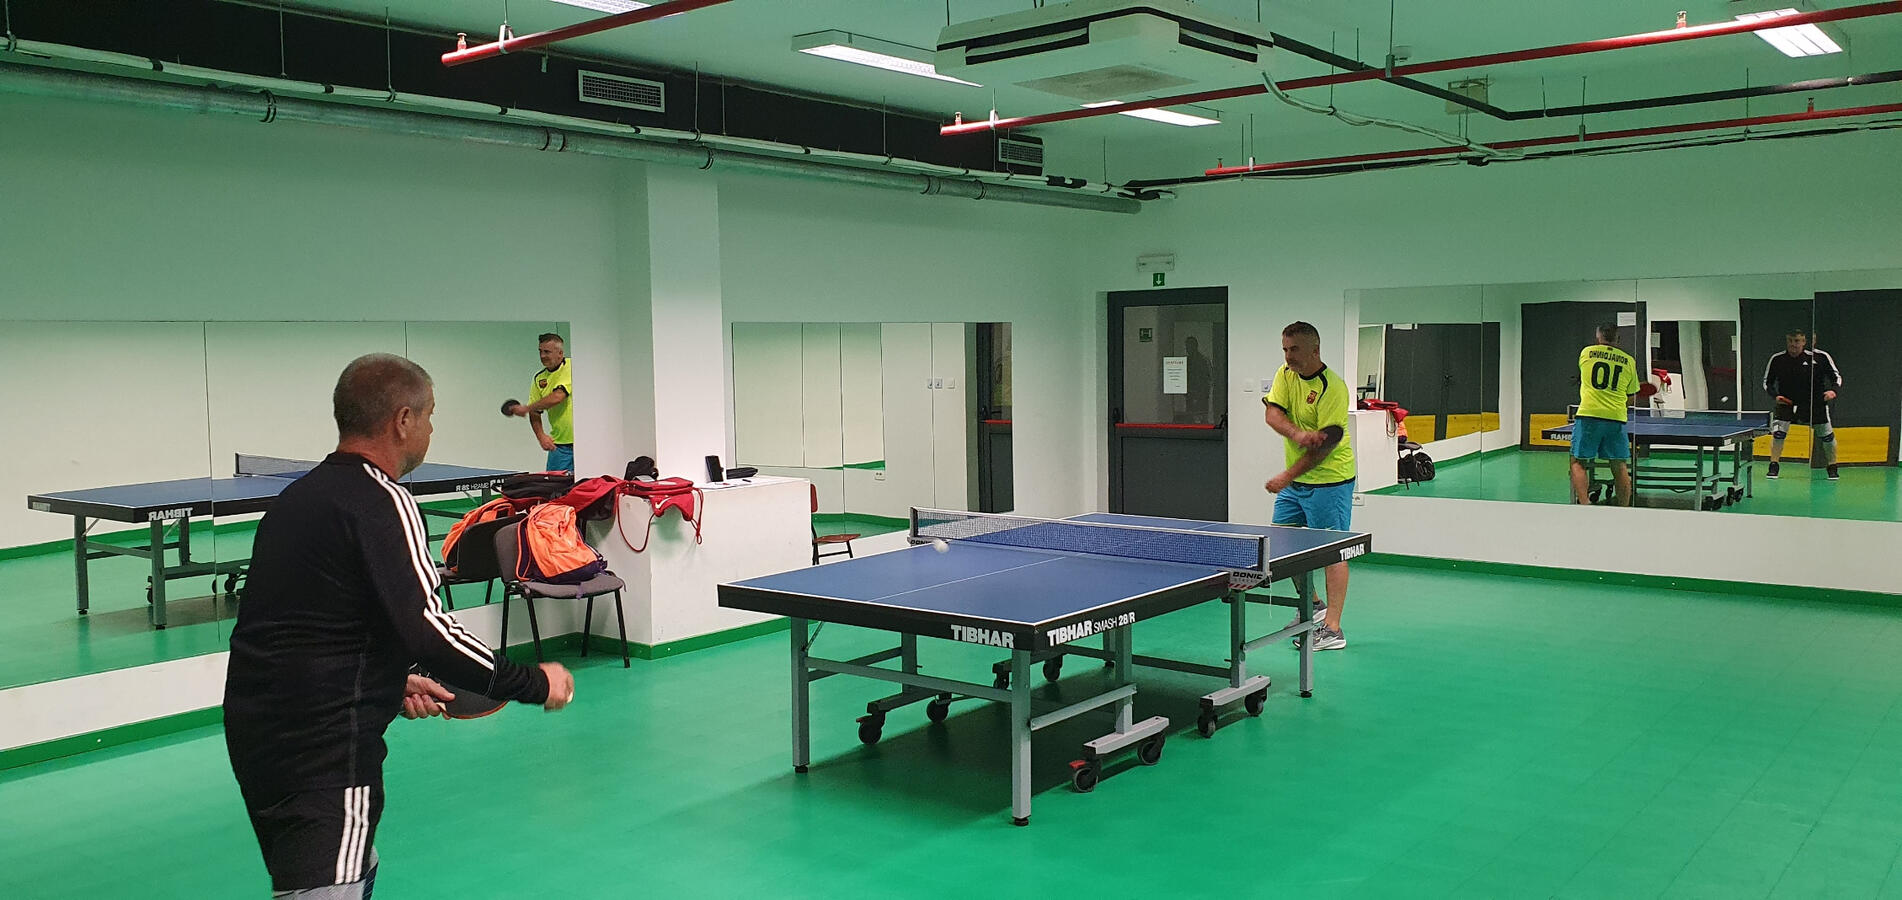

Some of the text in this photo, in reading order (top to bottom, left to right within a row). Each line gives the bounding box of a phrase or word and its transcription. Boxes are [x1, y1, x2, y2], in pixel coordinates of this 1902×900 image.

[1339, 543, 1365, 561] TIBHAR
[1233, 571, 1263, 580] DONIC
[951, 624, 1014, 648] TIBHAR
[1046, 620, 1092, 647] TIBHAR
[1093, 617, 1117, 633] SMASH
